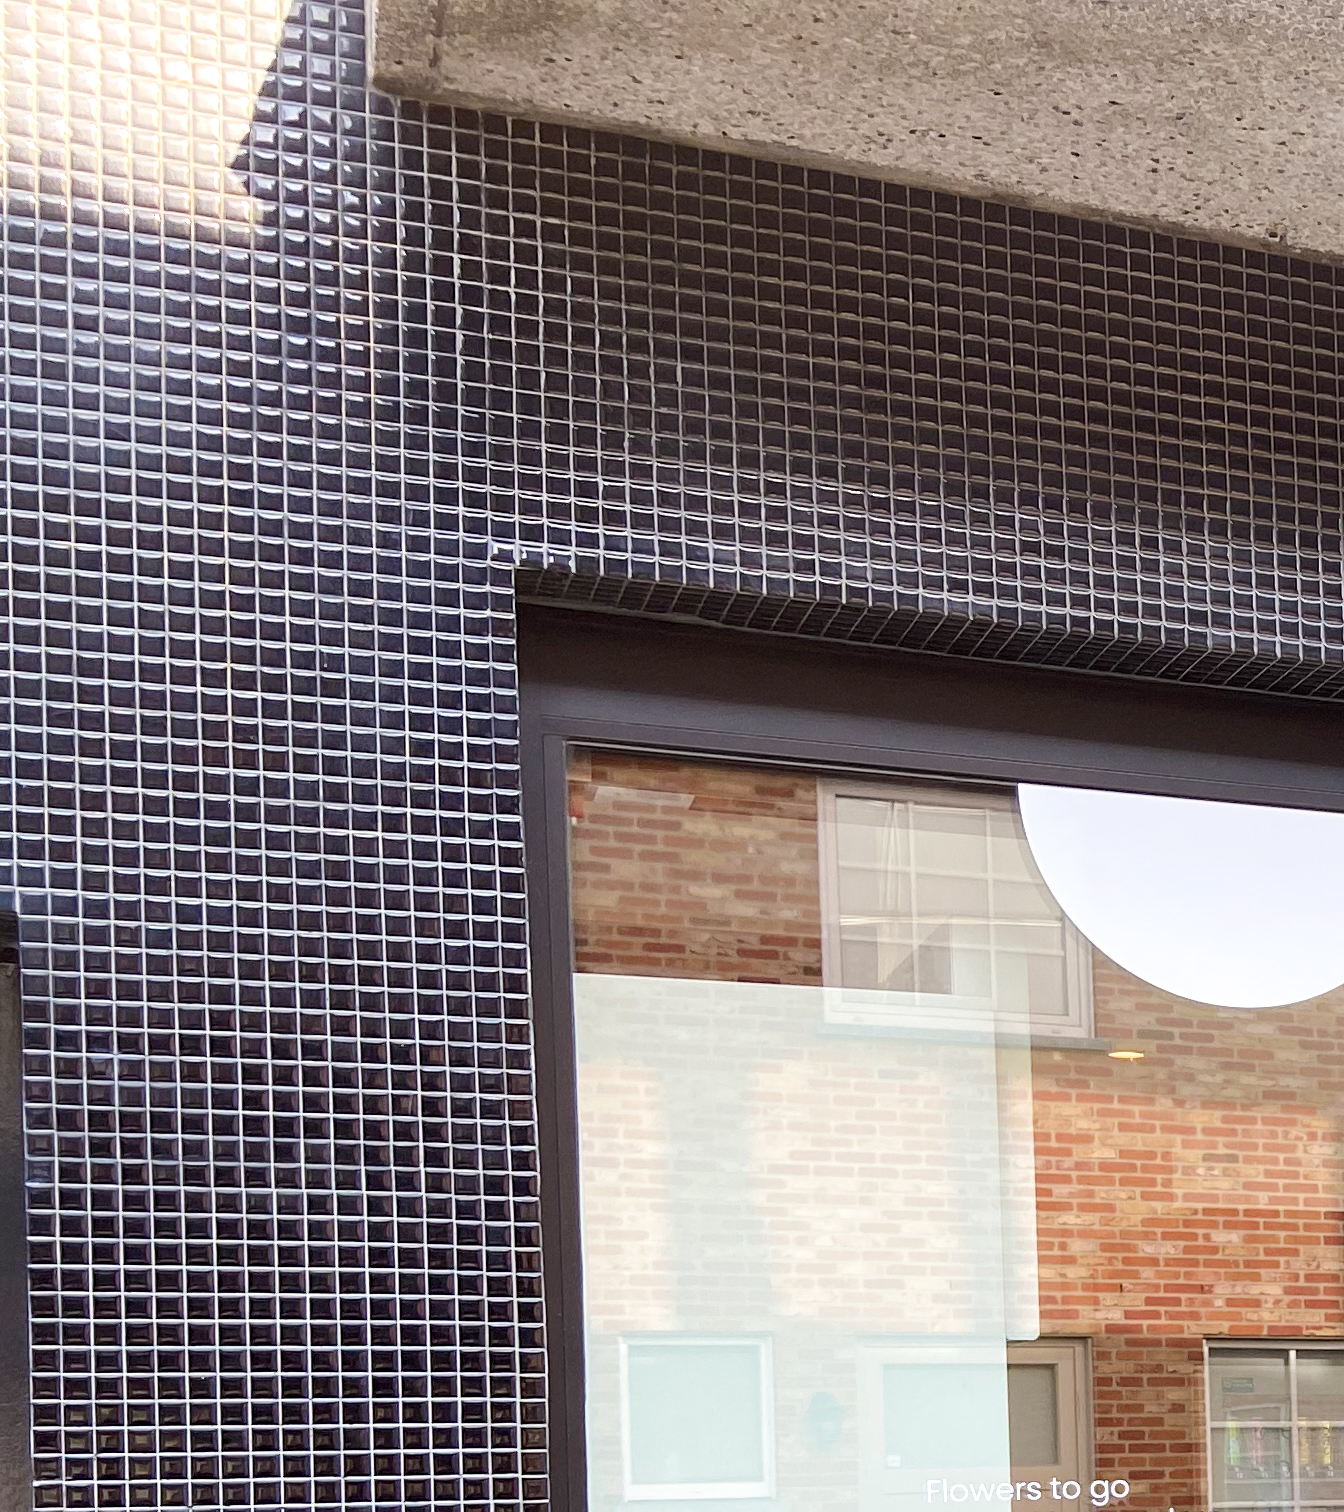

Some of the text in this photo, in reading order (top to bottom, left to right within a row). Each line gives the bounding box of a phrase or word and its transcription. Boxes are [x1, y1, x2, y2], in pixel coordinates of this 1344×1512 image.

[926, 1476, 1130, 1505] Flowers to go
